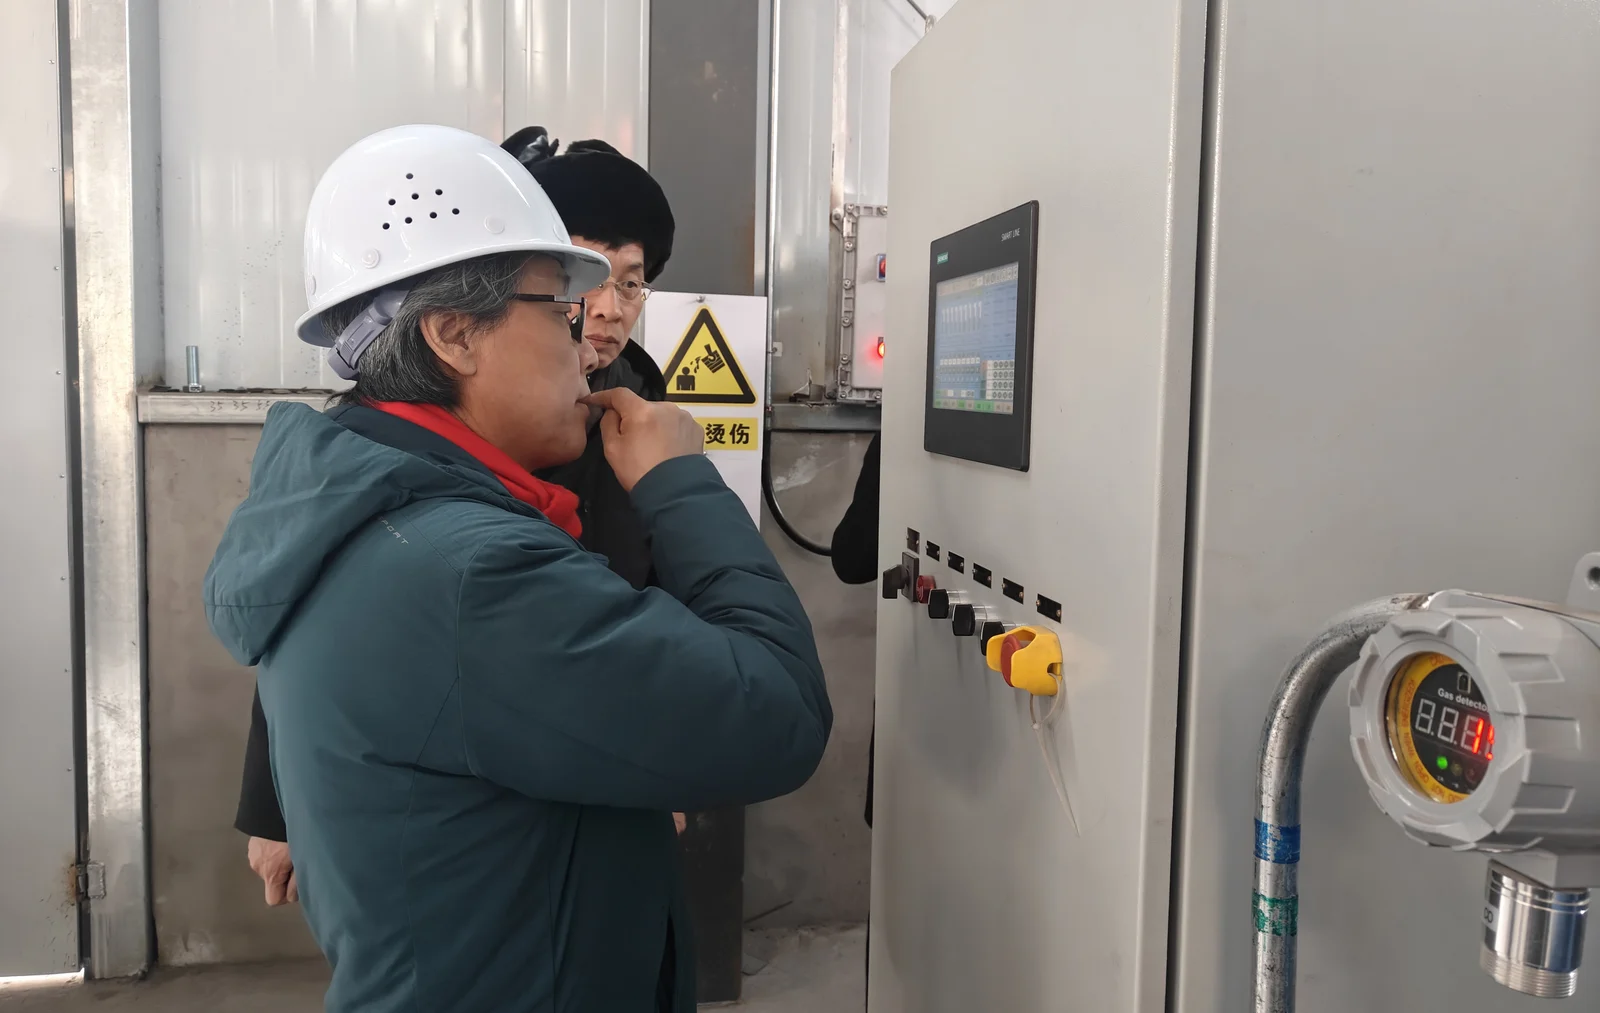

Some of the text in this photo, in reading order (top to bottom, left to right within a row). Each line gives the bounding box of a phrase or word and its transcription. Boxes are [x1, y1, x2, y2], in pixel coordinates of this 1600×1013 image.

[705, 423, 751, 445] 烫伤
[1437, 687, 1489, 712] Gas detecto
